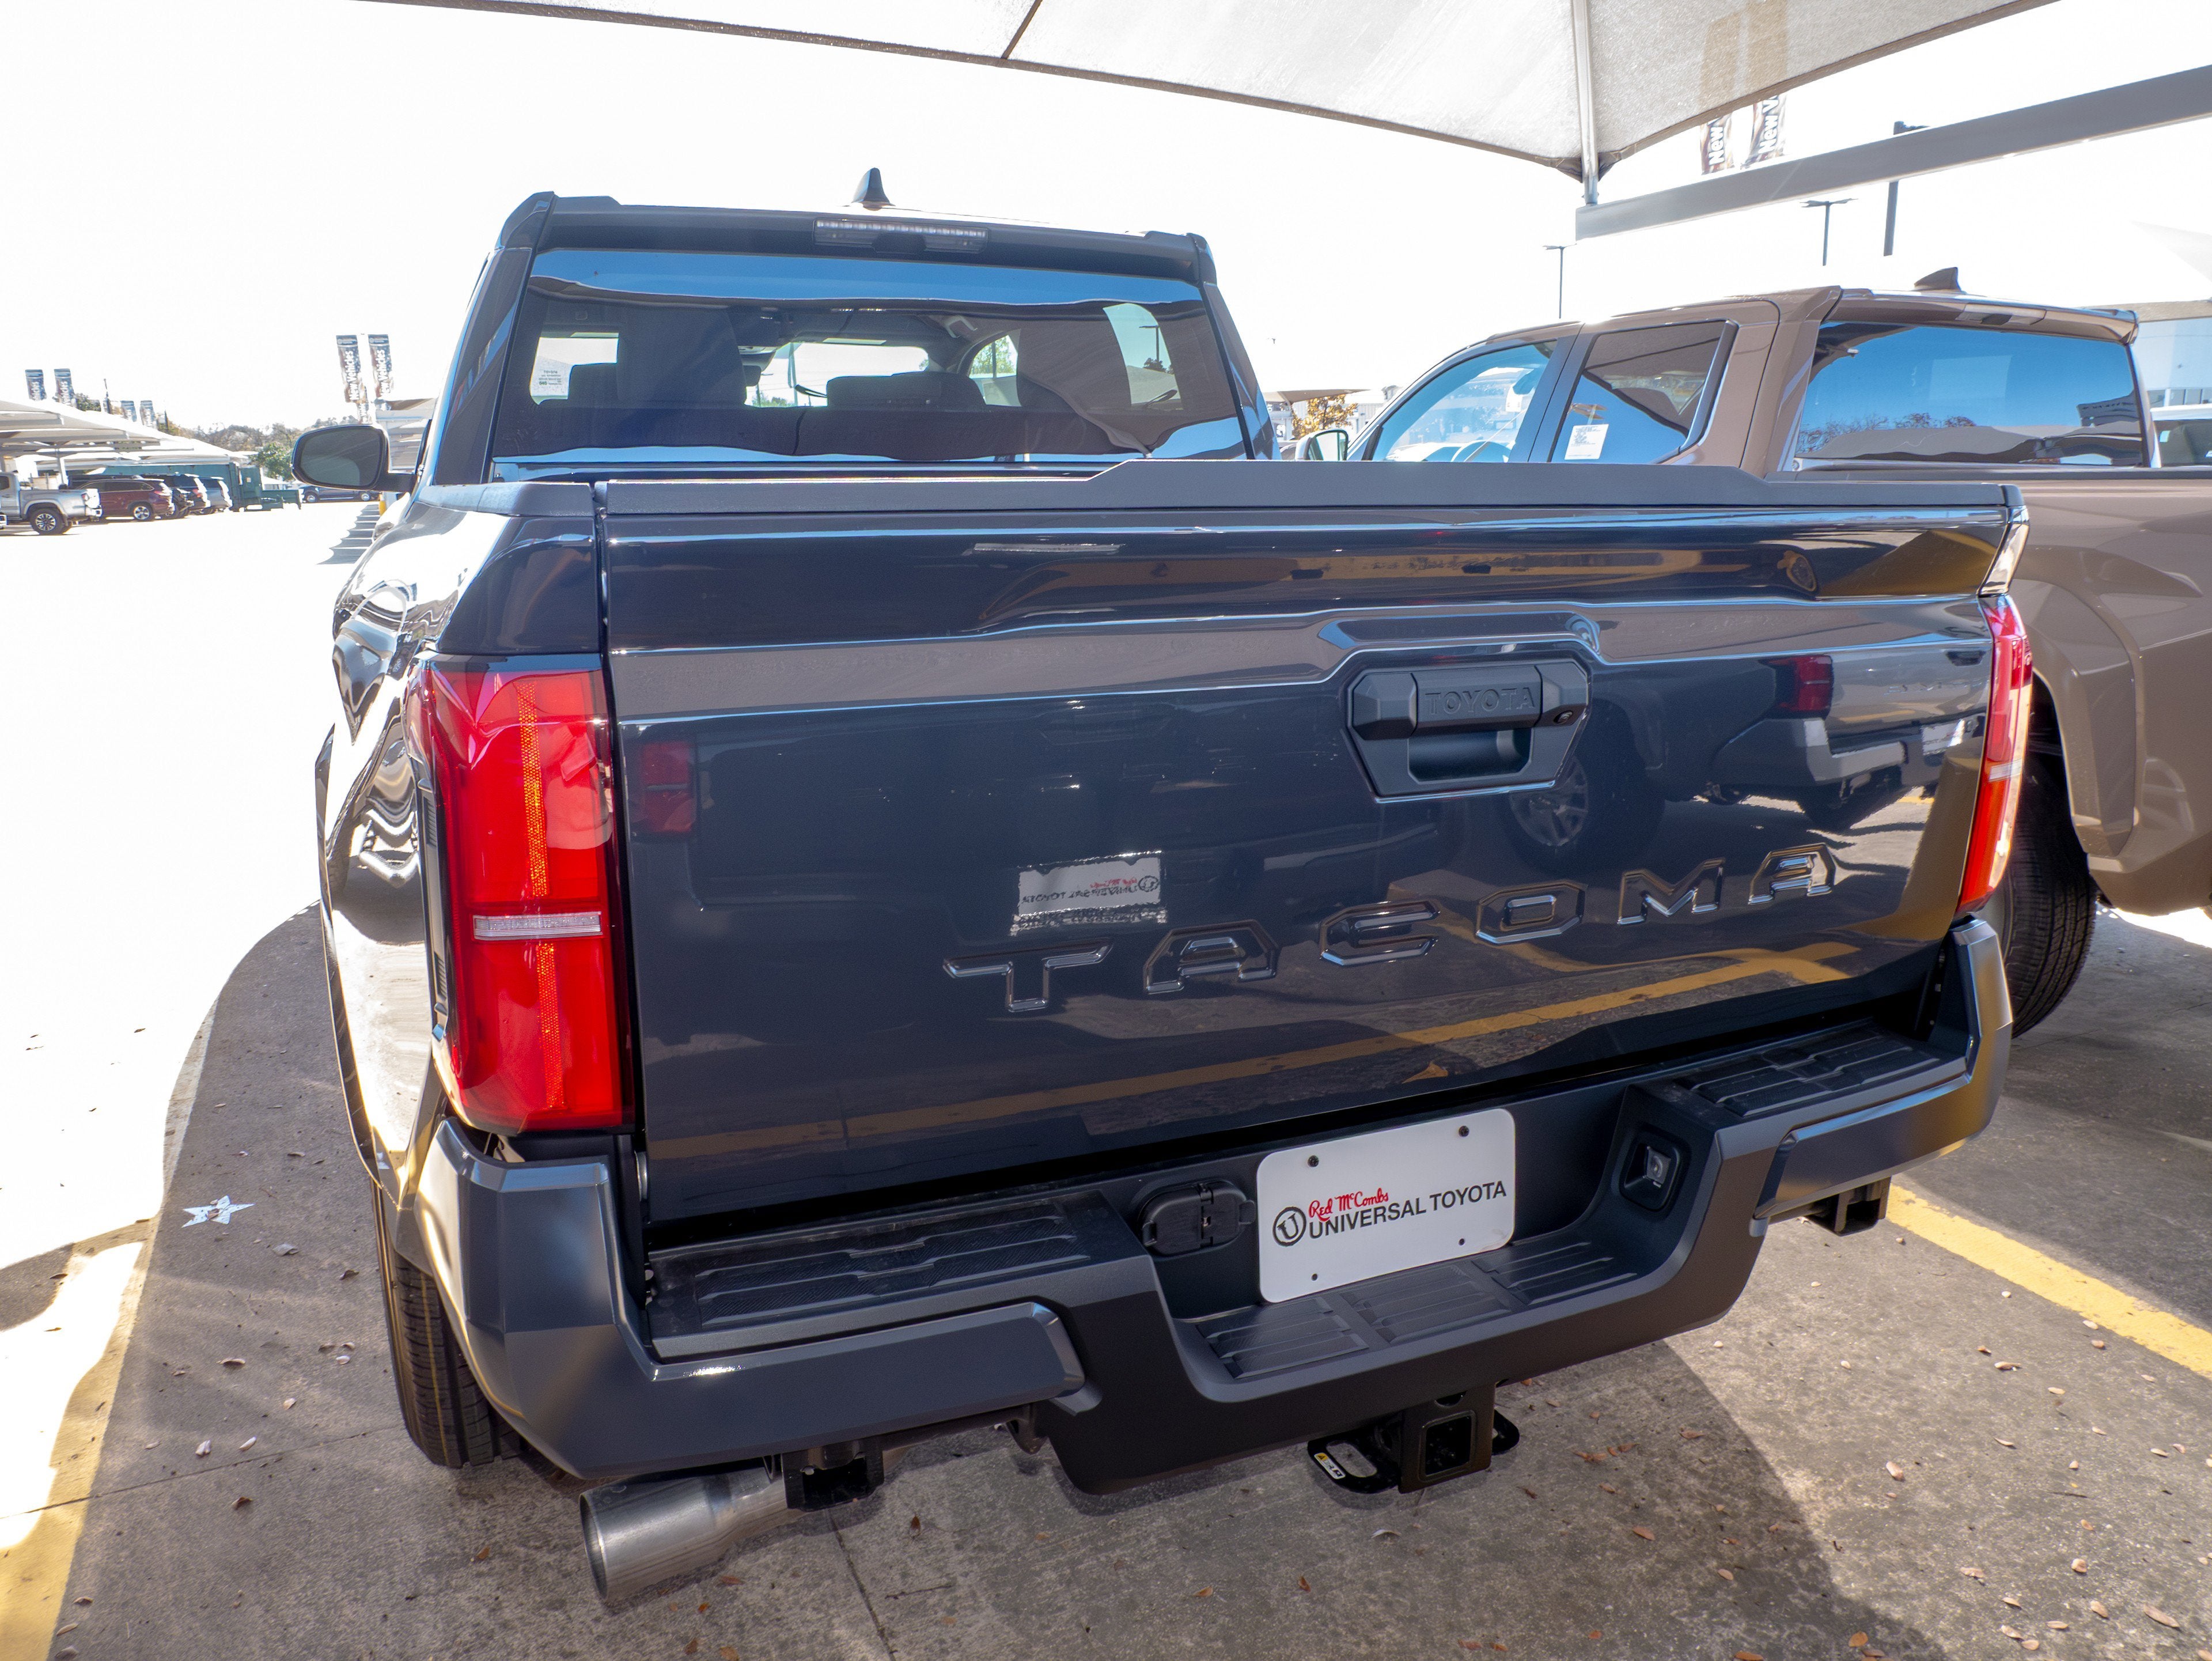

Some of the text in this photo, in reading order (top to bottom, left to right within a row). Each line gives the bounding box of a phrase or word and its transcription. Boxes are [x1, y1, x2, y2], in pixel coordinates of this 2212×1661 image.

[1709, 127, 1725, 166] New
[1758, 115, 1779, 154] New
[344, 350, 358, 383] Vehicles
[375, 349, 388, 381] Vehicles
[349, 383, 360, 400] New
[1425, 687, 1535, 714] TOYOTA
[943, 842, 1836, 1013] TACOMA
[1308, 1187, 1389, 1221] Red McCombs
[1309, 1181, 1507, 1239] UNIVERSAL TOYOTA
